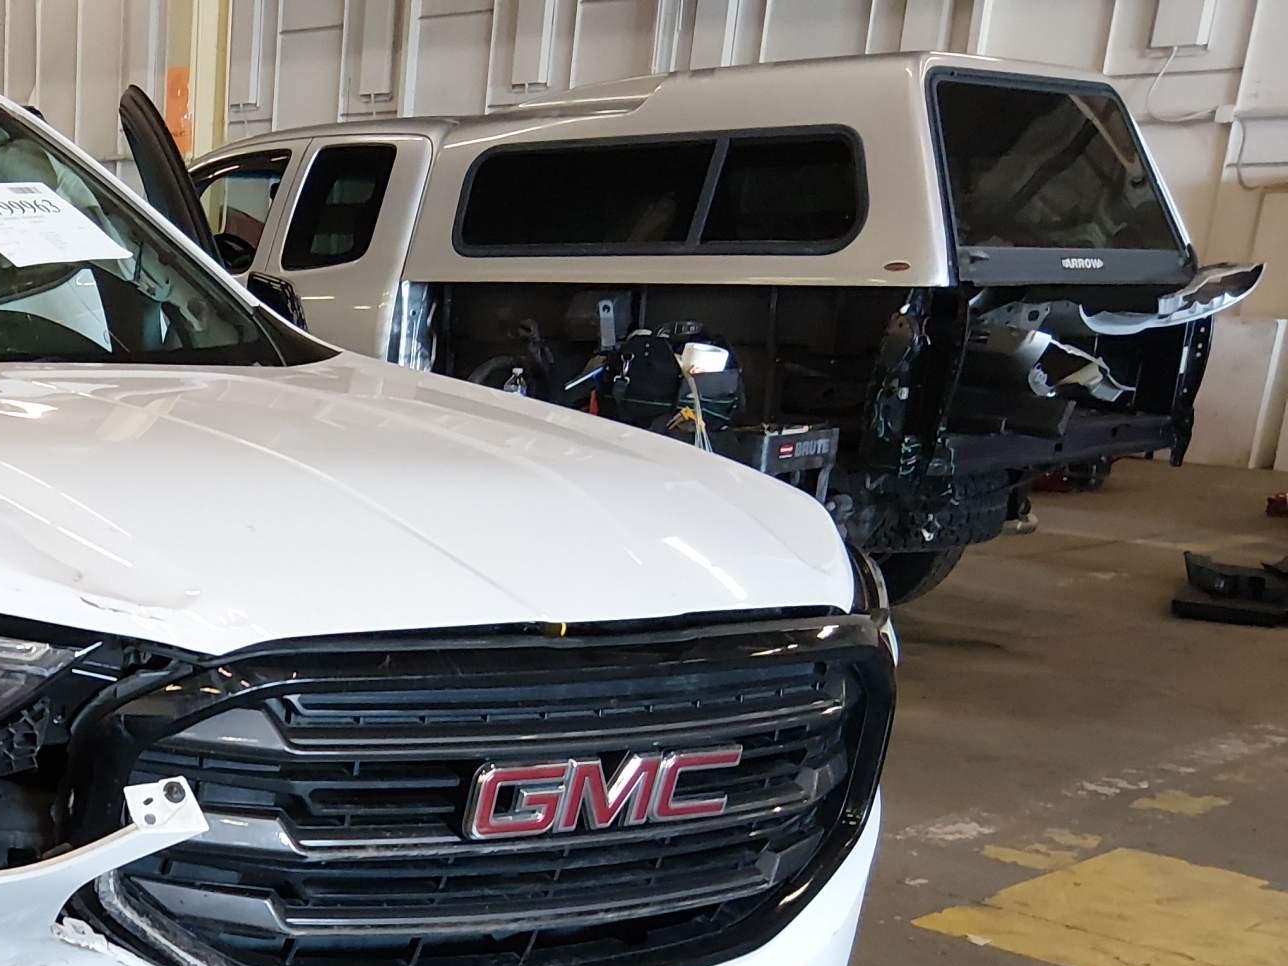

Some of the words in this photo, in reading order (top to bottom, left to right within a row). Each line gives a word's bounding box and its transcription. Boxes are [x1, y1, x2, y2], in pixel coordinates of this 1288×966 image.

[1063, 258, 1103, 269] ARROW
[794, 438, 831, 457] BRUTE
[464, 744, 743, 840] GMC
